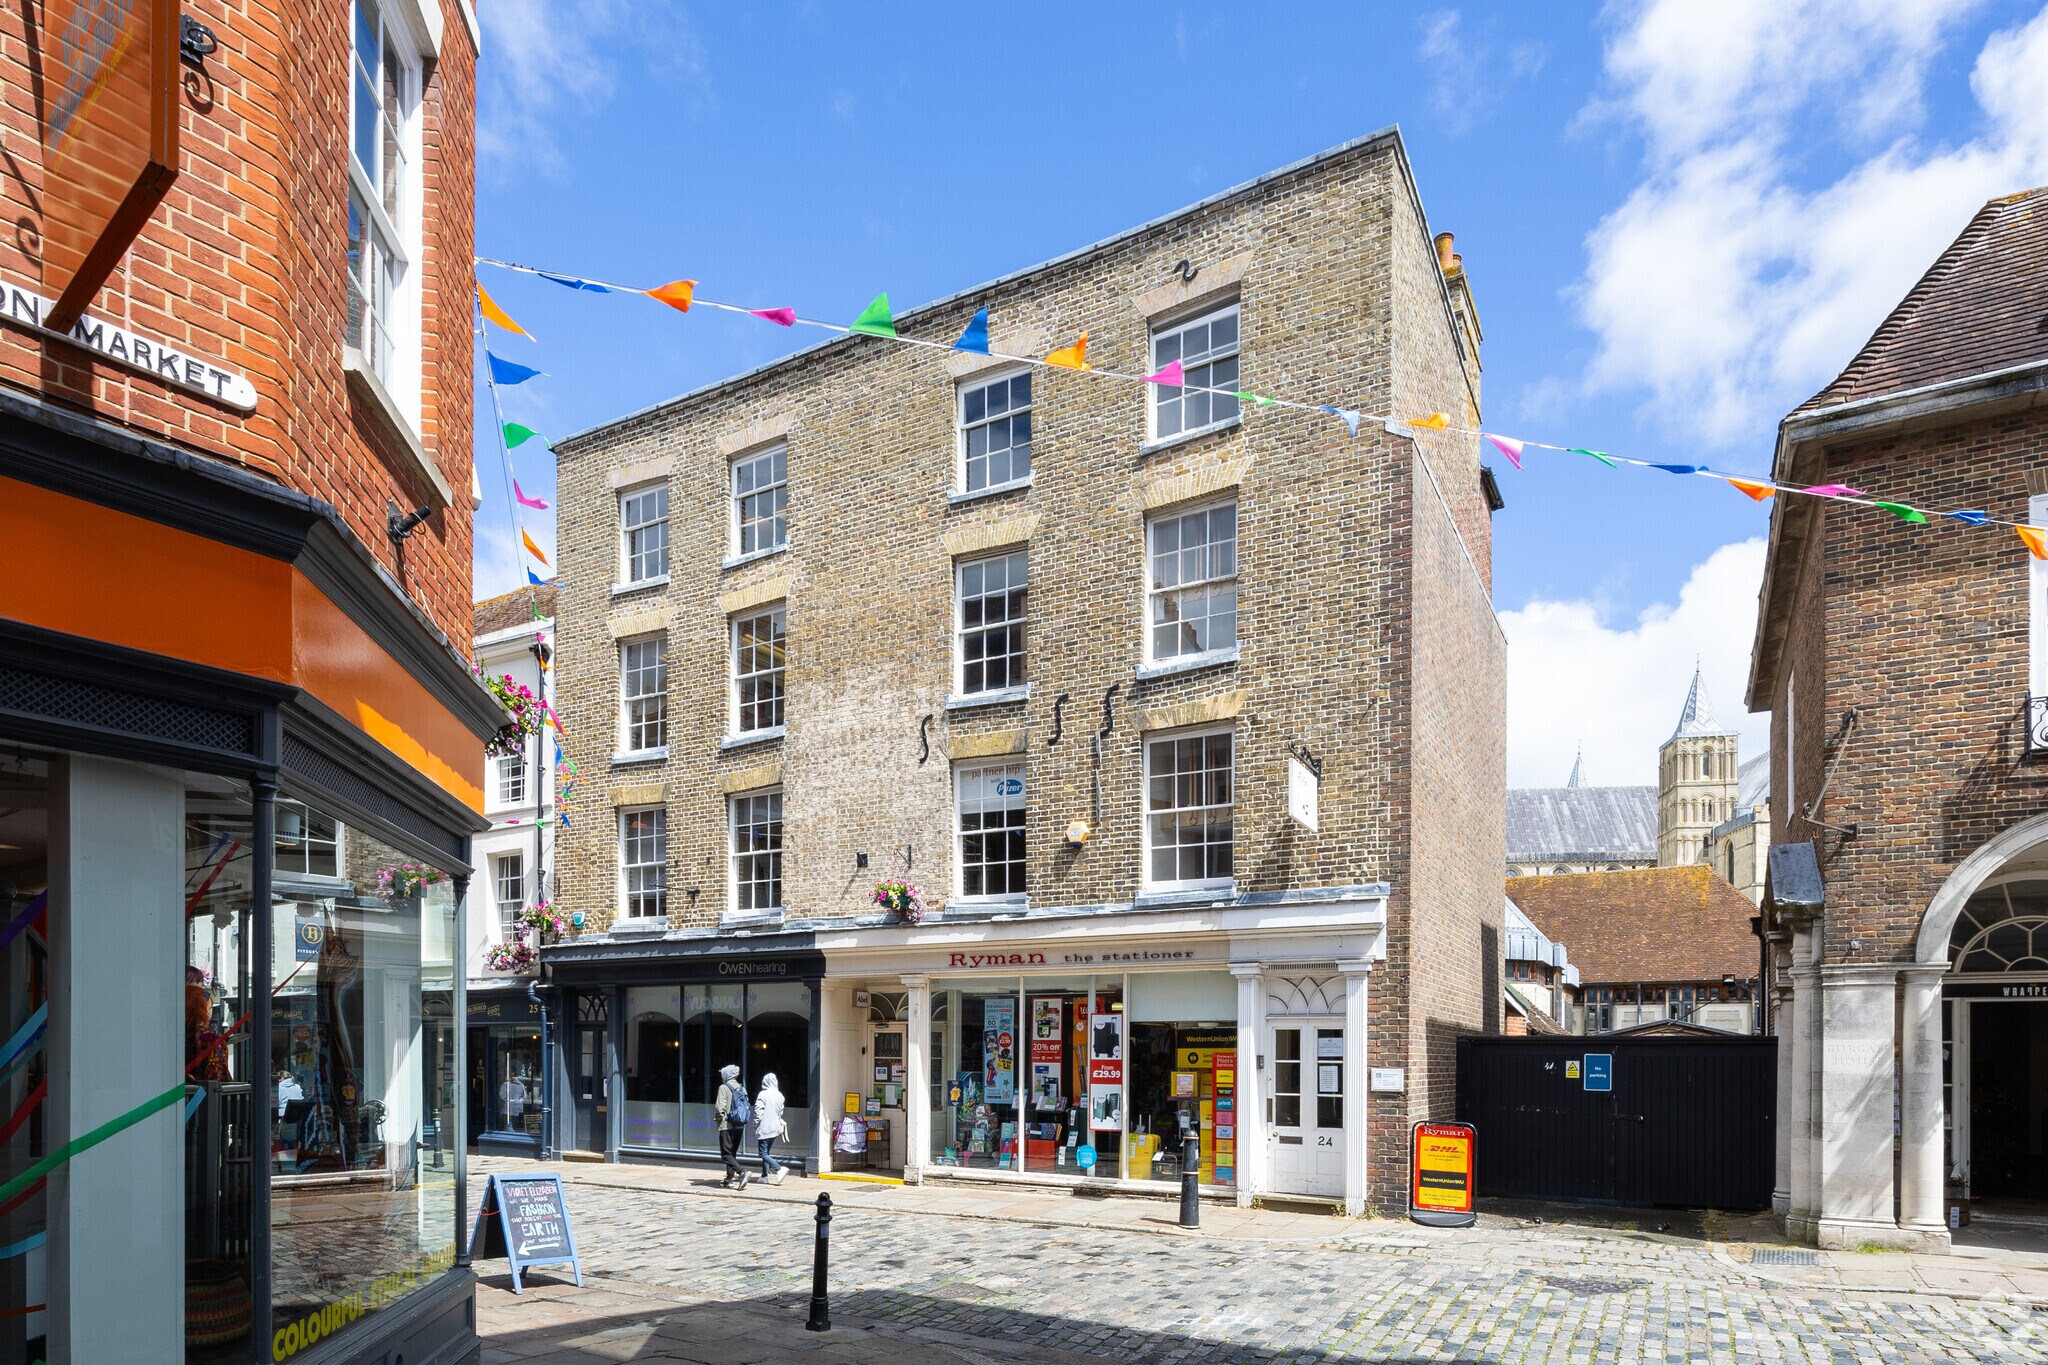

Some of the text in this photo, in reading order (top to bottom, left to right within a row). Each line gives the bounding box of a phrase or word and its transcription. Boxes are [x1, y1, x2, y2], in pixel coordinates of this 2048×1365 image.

[0, 285, 231, 396] N MARKET
[949, 951, 1194, 968] Ryman the stationer
[529, 1005, 538, 1013] 25
[1033, 1043, 1049, 1051] 20%
[1827, 1044, 1890, 1053] BURGATE
[1834, 1056, 1884, 1065] HOUSE
[1092, 1070, 1120, 1078] £29.99
[1424, 1126, 1465, 1136] Ryman
[1317, 1136, 1333, 1147] 24
[1430, 1145, 1460, 1153] DHL
[505, 1186, 529, 1197] VIOLET
[521, 1221, 560, 1236] EARTH
[272, 1290, 366, 1362] COLOURFUL
